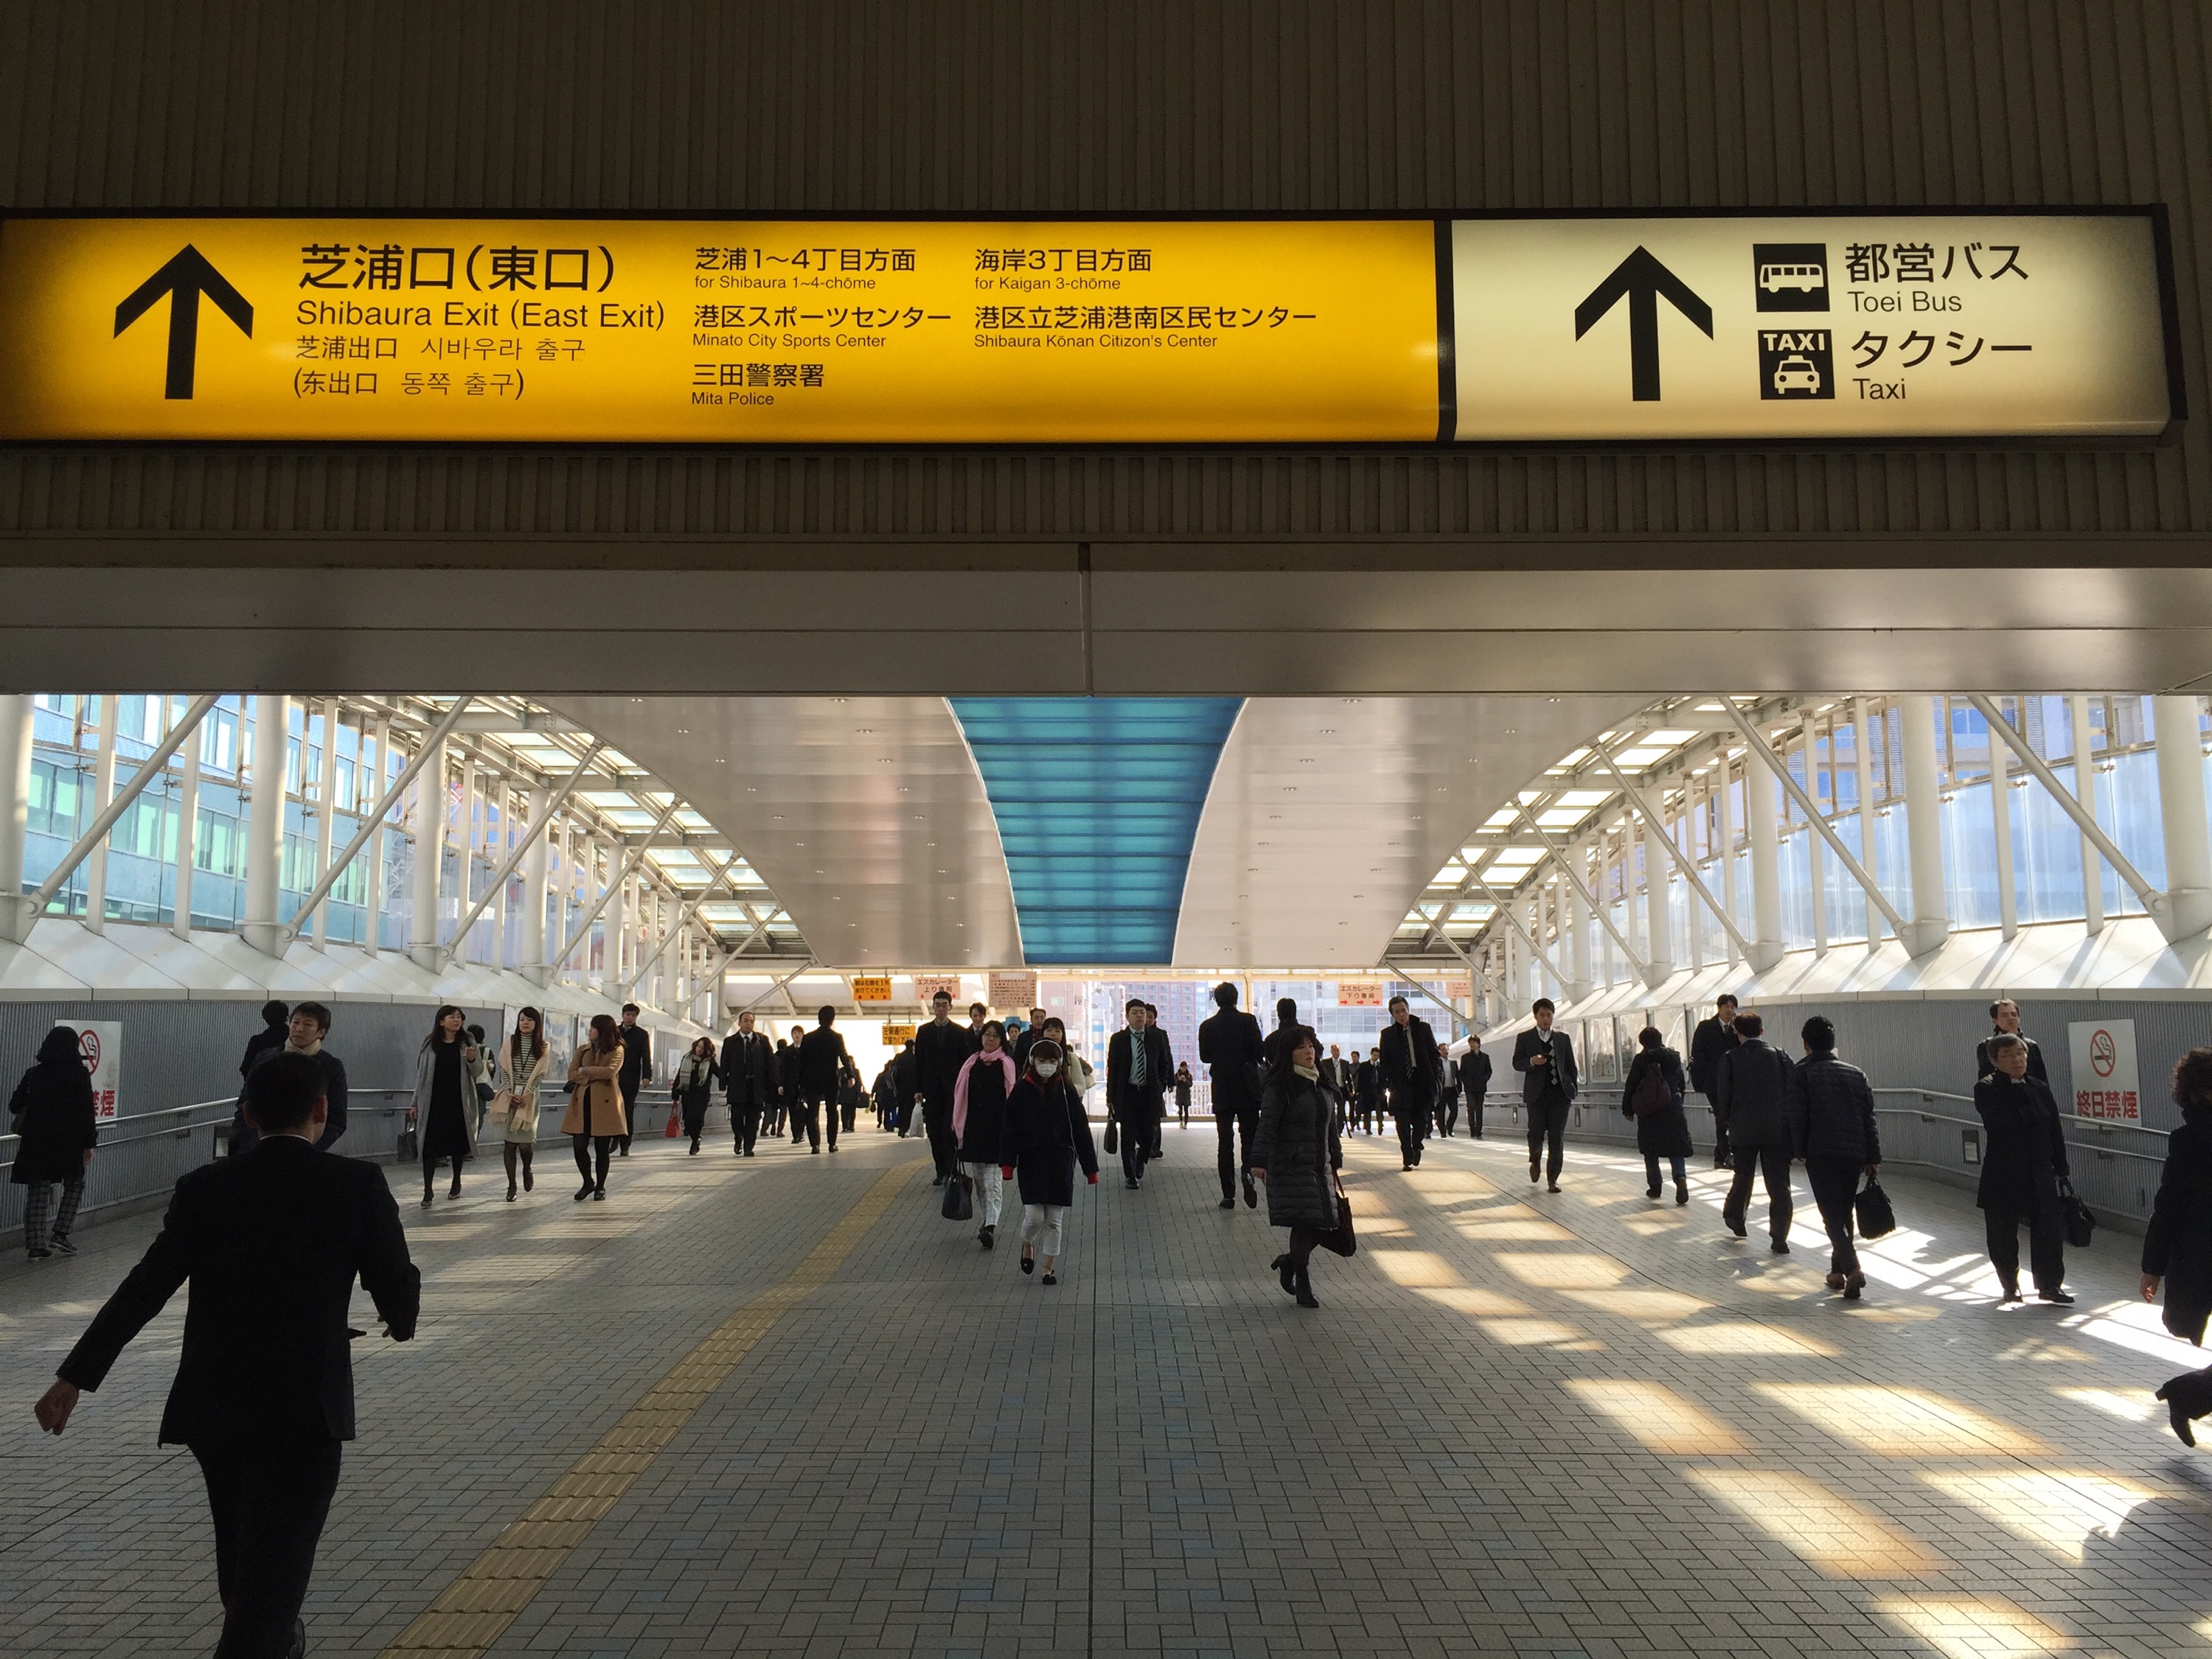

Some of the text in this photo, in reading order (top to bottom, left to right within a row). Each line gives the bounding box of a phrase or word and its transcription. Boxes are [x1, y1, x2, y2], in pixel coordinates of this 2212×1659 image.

[299, 243, 613, 292] 芝浦口(東口)
[975, 248, 1151, 271] 海岸3丁目方面
[1846, 242, 2028, 282] 都営バス
[695, 276, 714, 288] for
[720, 276, 786, 288] Shibaura
[975, 277, 1120, 292] for Kaigan 3-chōme
[1847, 291, 1961, 312] Toei Bus
[297, 299, 664, 331] Shibaura Exit (East Exit)
[695, 305, 950, 328] 港区スポーツセンター
[975, 306, 1316, 329] 港区立芝浦港南区民センター
[296, 335, 585, 361] 芝浦出口 시바우라 출구
[693, 333, 886, 349] Minato City Sports Center
[975, 334, 1217, 347] Shibaura Kōnan Citizon's Center
[1763, 333, 1825, 351] TAXI
[1851, 330, 2032, 369] タクシー
[294, 368, 524, 400] (东出口 동쪽 출구)
[693, 364, 824, 387] 三田警察署
[692, 392, 774, 405] Mita Police
[1853, 378, 1905, 400] Taxi
[2076, 1090, 2138, 1119] 終日禁煙
